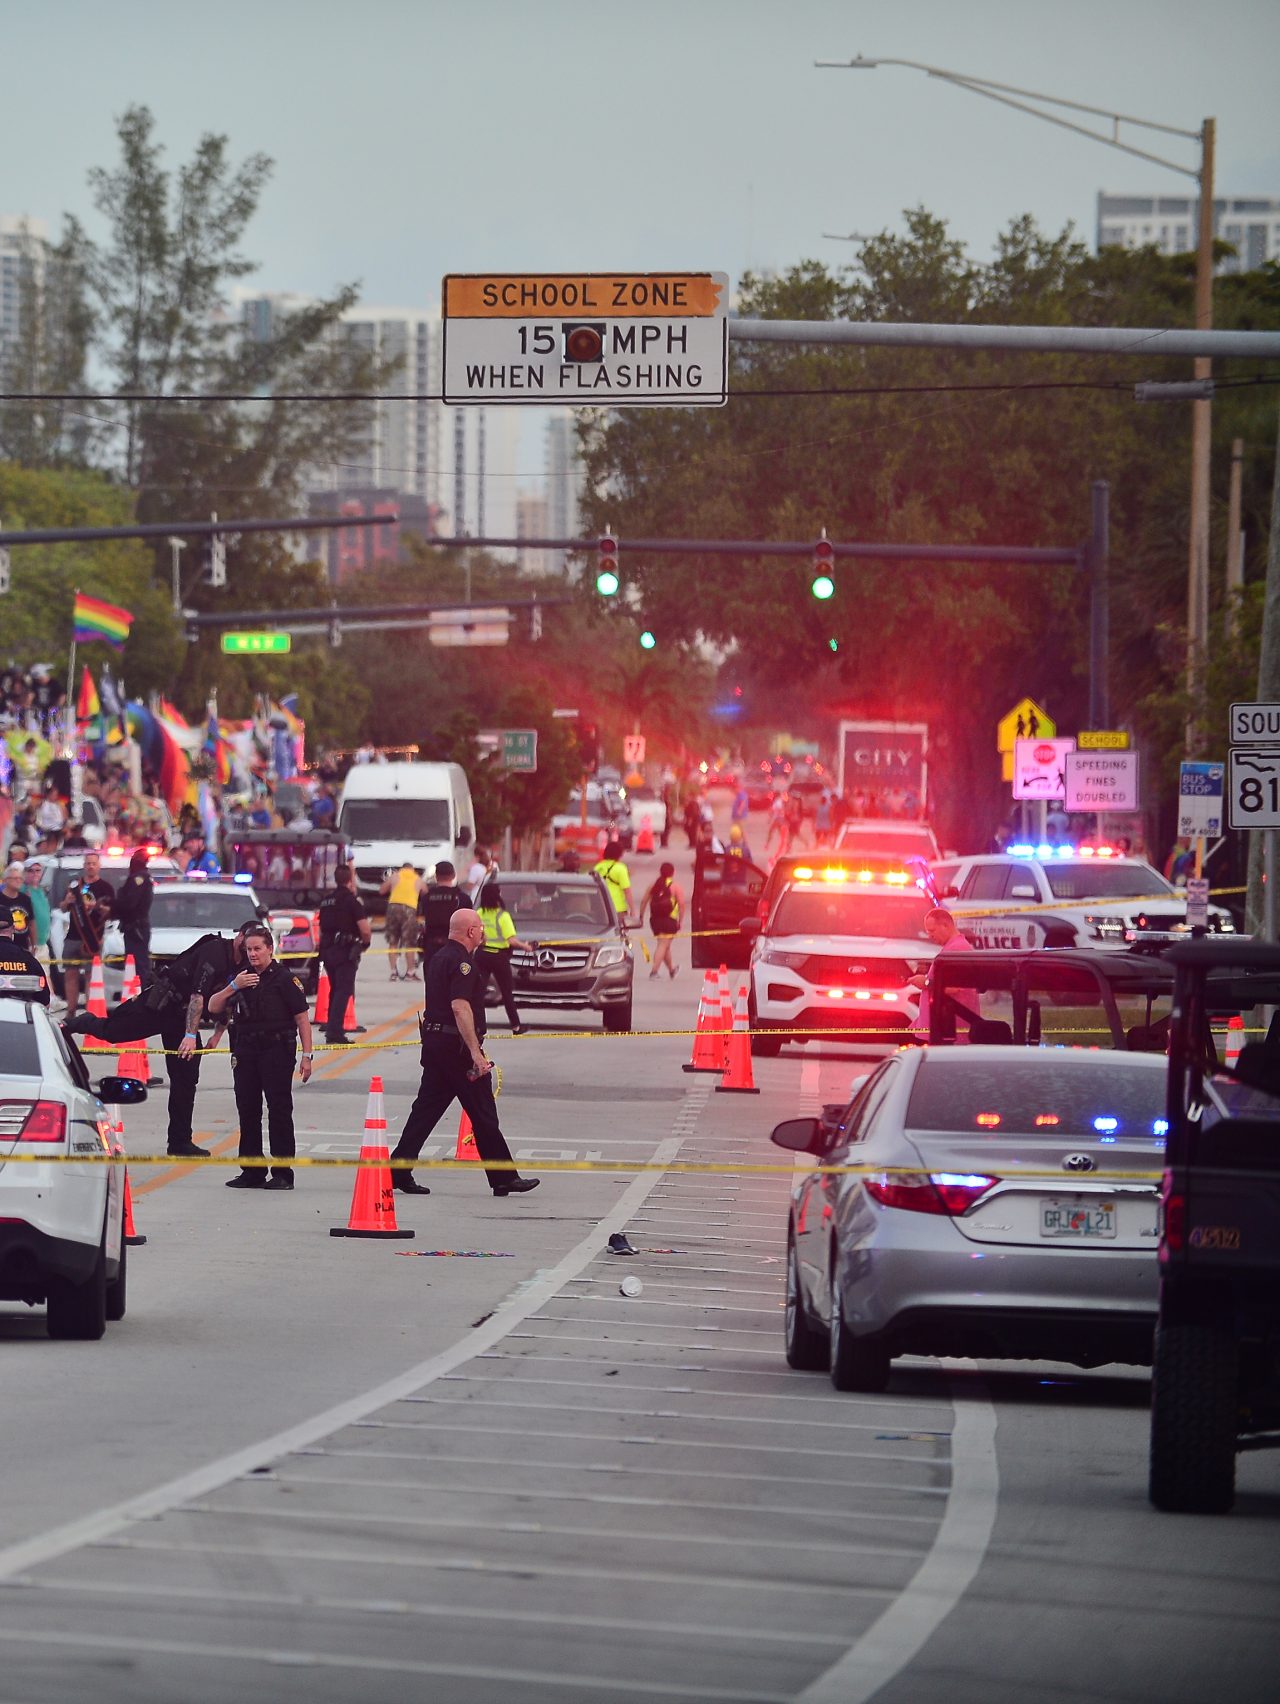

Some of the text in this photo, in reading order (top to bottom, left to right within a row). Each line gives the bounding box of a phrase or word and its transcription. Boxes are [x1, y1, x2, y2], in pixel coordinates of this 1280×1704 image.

[482, 282, 688, 307] SCHOOL ZONE
[518, 325, 688, 355] 15 MPH
[466, 364, 703, 388] WHEN FLASHING
[1082, 736, 1124, 746] SCHOOL
[853, 749, 913, 767] CITY
[1075, 760, 1128, 771] SPEEDING
[1086, 777, 1117, 787] FINES
[1182, 774, 1206, 785] BUS
[1182, 784, 1213, 795] STOP
[1076, 792, 1127, 803] DOUBLED
[973, 936, 1021, 950] OLICE
